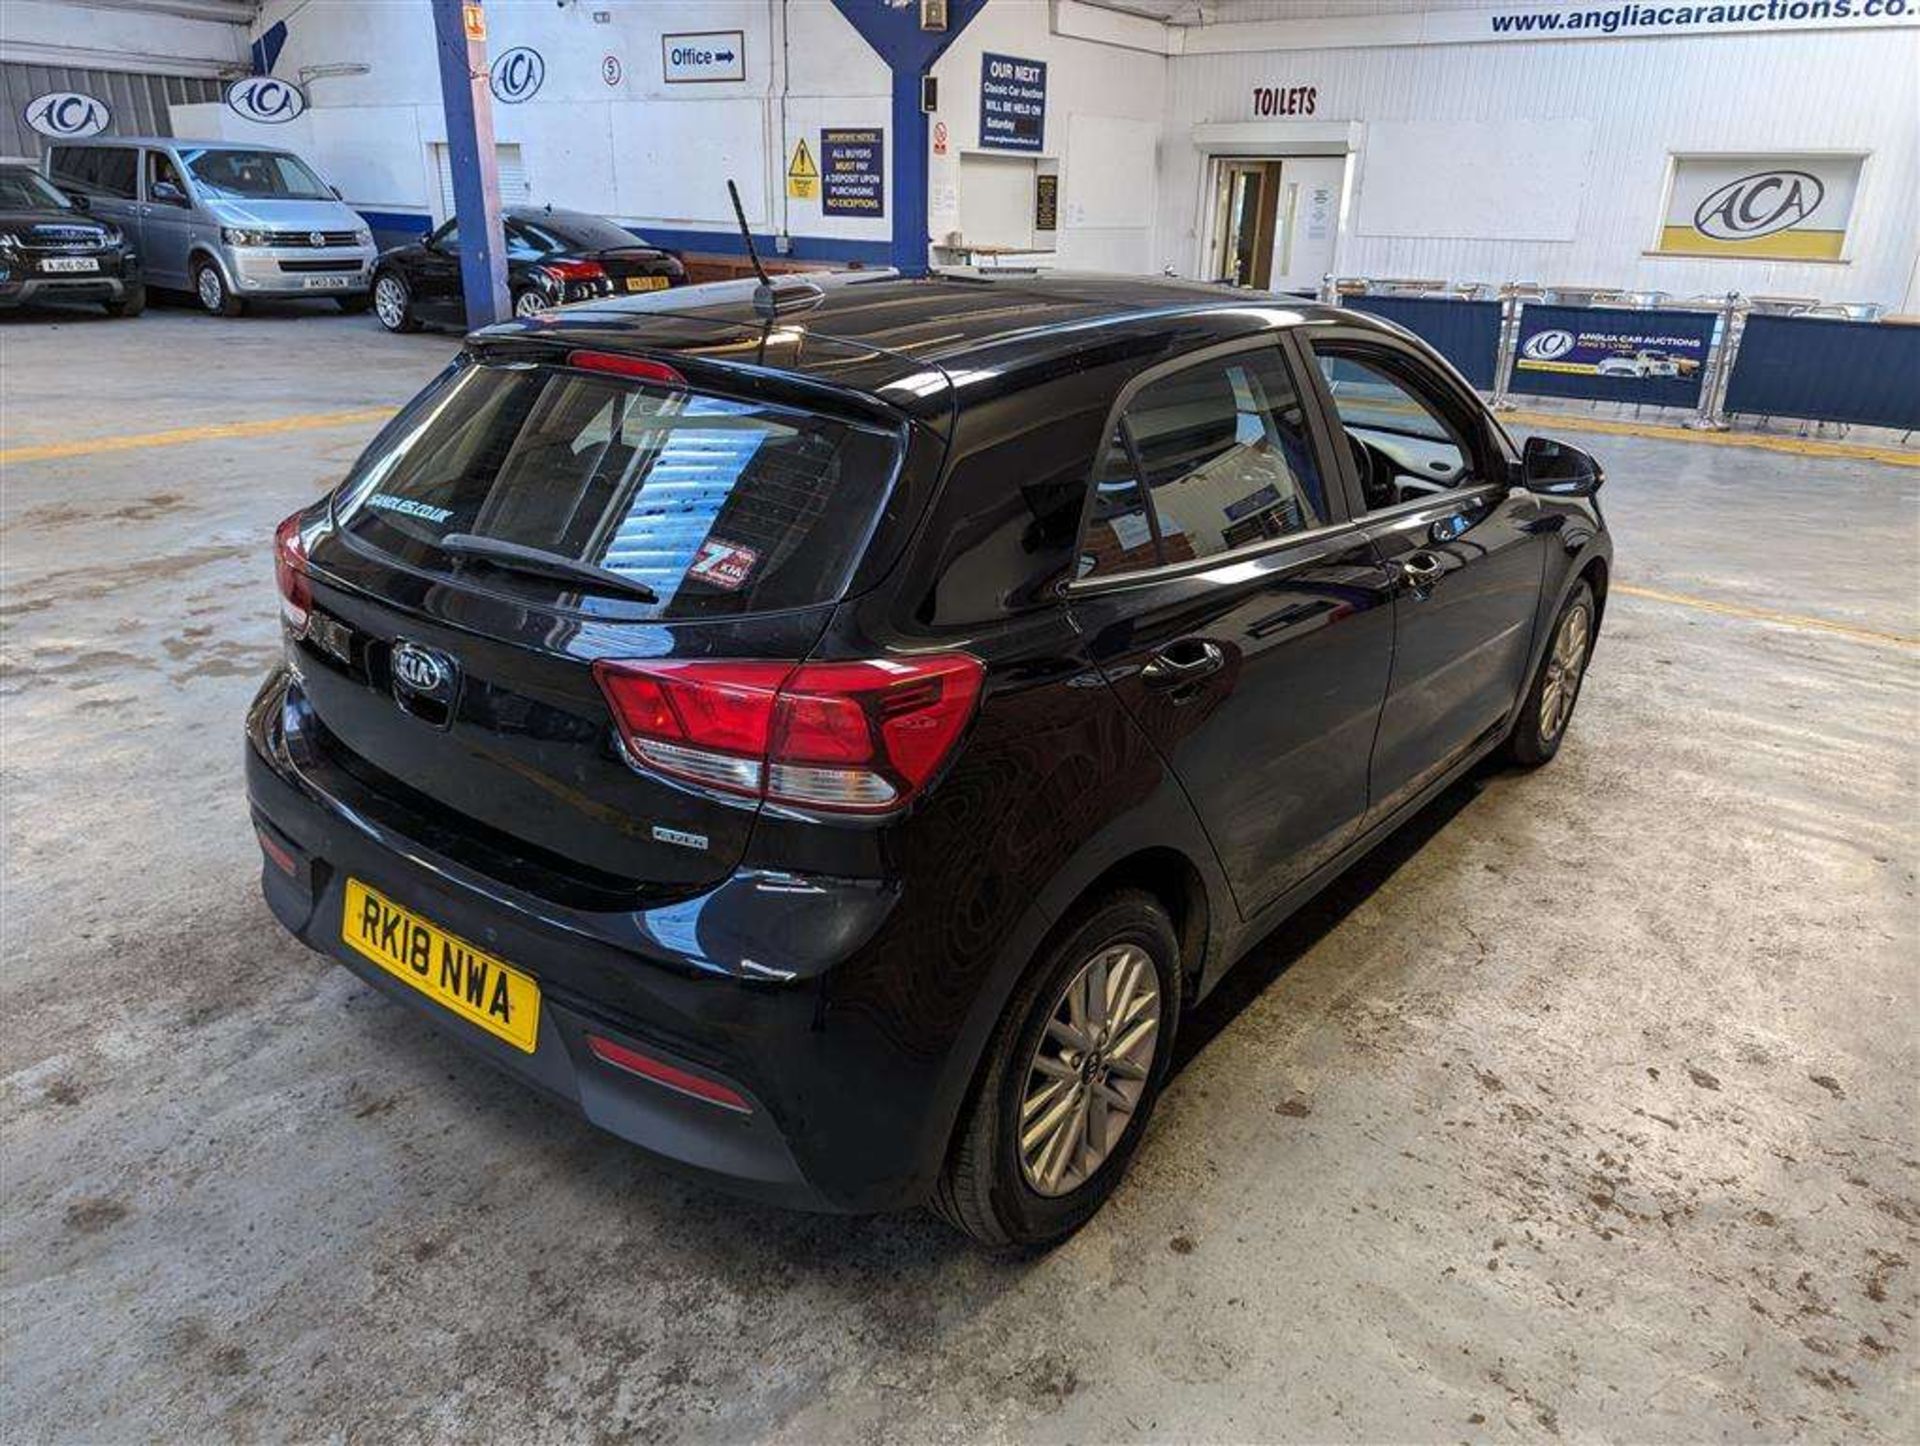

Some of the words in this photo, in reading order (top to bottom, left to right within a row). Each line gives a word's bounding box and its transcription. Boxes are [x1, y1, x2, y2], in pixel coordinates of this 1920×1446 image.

[671, 48, 713, 66] Office
[990, 61, 1013, 80] OUR
[1015, 65, 1040, 83] NEXT
[232, 82, 295, 117] ACA
[986, 99, 1002, 113] WILL
[1002, 101, 1012, 113] BE
[1013, 103, 1030, 115] HELD
[1031, 105, 1042, 116] ON
[1253, 86, 1317, 117] TOILETS
[31, 97, 101, 133] ACA
[987, 116, 1016, 134] Saturday
[832, 149, 844, 158] ALL
[844, 148, 872, 159] BUYERS
[834, 161, 855, 171] MUST
[855, 161, 869, 171] PAY
[831, 173, 859, 183] DEPOSIT
[859, 174, 880, 184] UPON
[831, 186, 875, 197] PURCHASING
[1700, 177, 1805, 231] ACA
[1578, 333, 1618, 343] ANGLIA
[1619, 336, 1643, 344] CAR
[1643, 336, 1701, 348] AUCTIONS
[399, 653, 432, 686] KIA
[362, 894, 430, 976] RK18
[440, 940, 510, 1024] NWA
